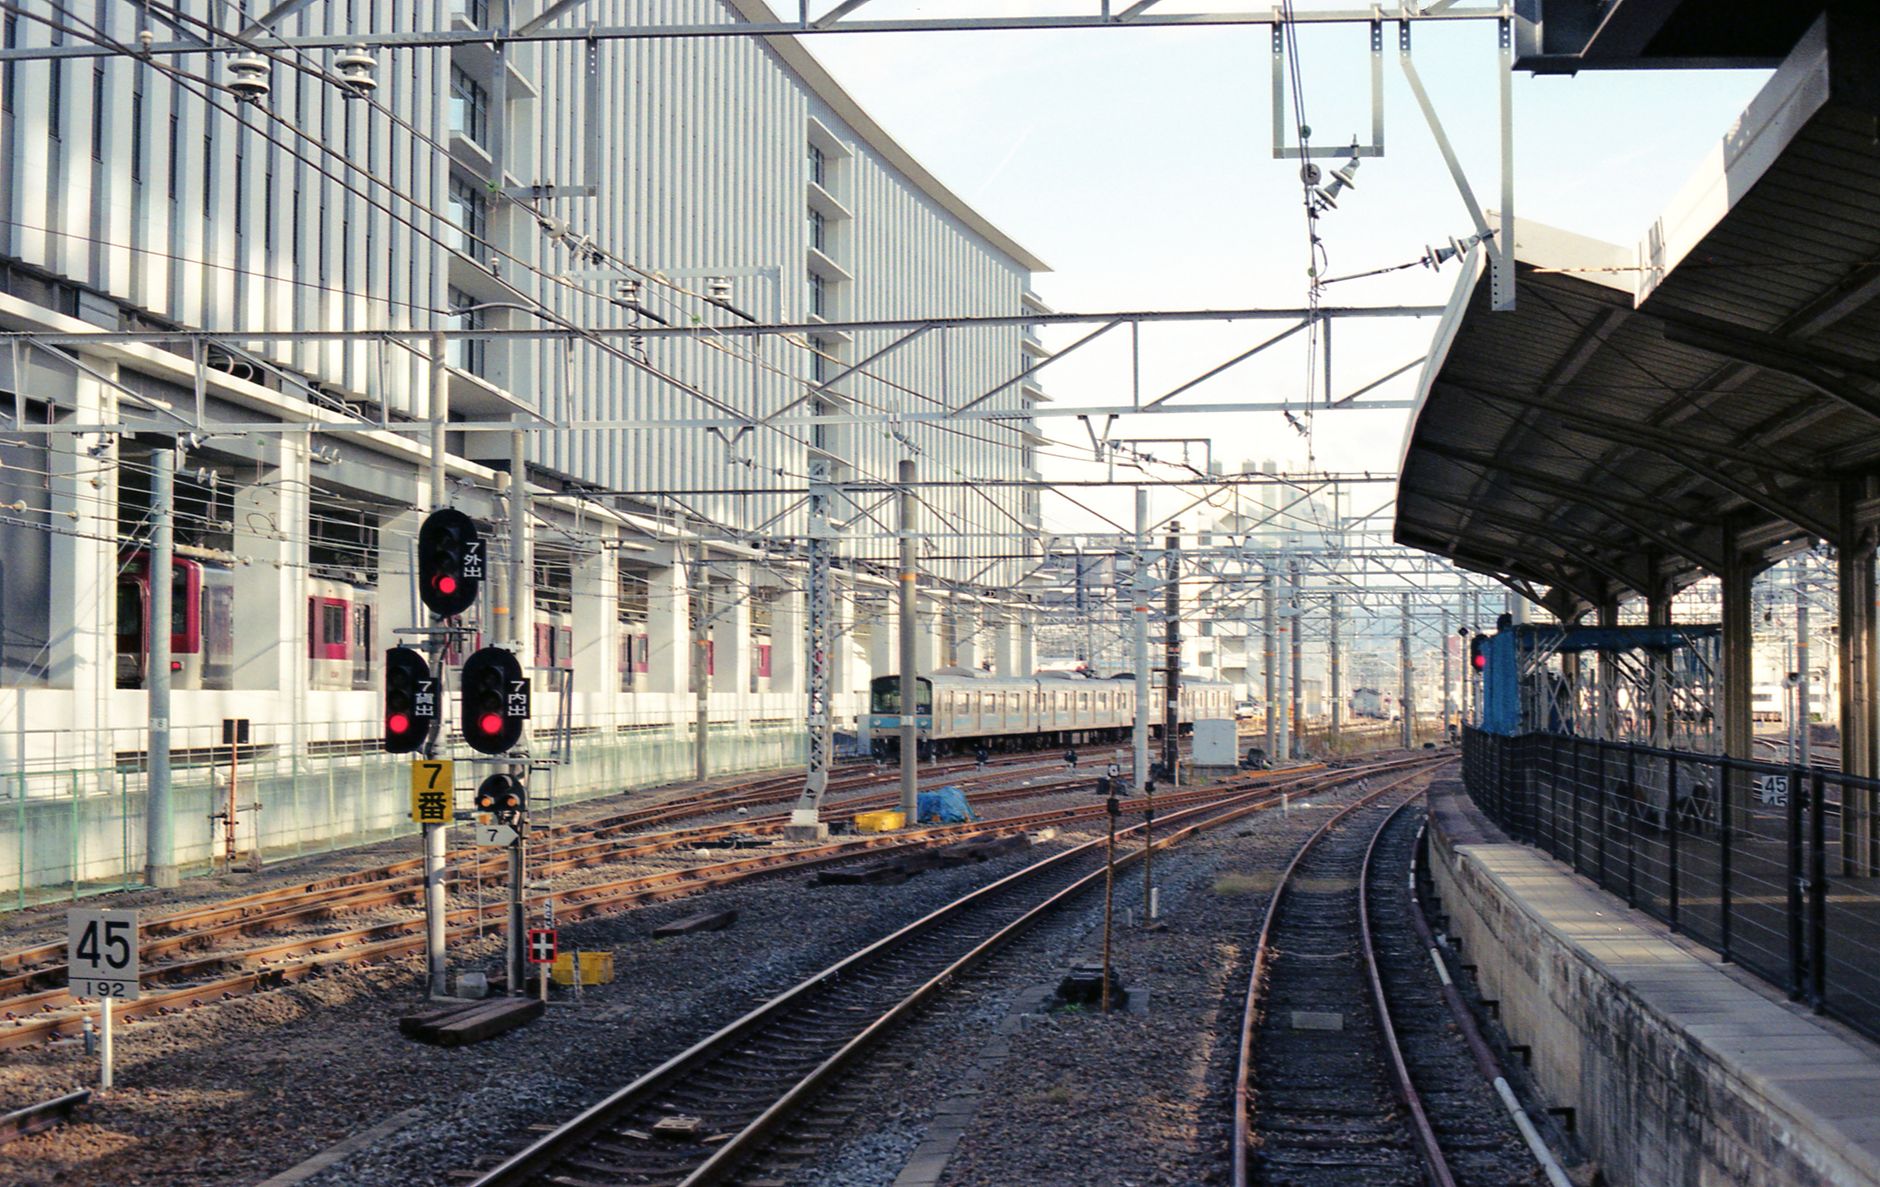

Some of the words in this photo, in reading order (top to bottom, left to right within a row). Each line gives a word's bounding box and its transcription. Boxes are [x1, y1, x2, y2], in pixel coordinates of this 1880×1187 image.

[463, 541, 482, 578] 7外出
[507, 680, 527, 716] 7内出
[418, 763, 446, 820] 7番
[1765, 776, 1787, 793] 45
[487, 829, 498, 842] 7
[76, 920, 130, 969] 45
[87, 981, 125, 997] 192
